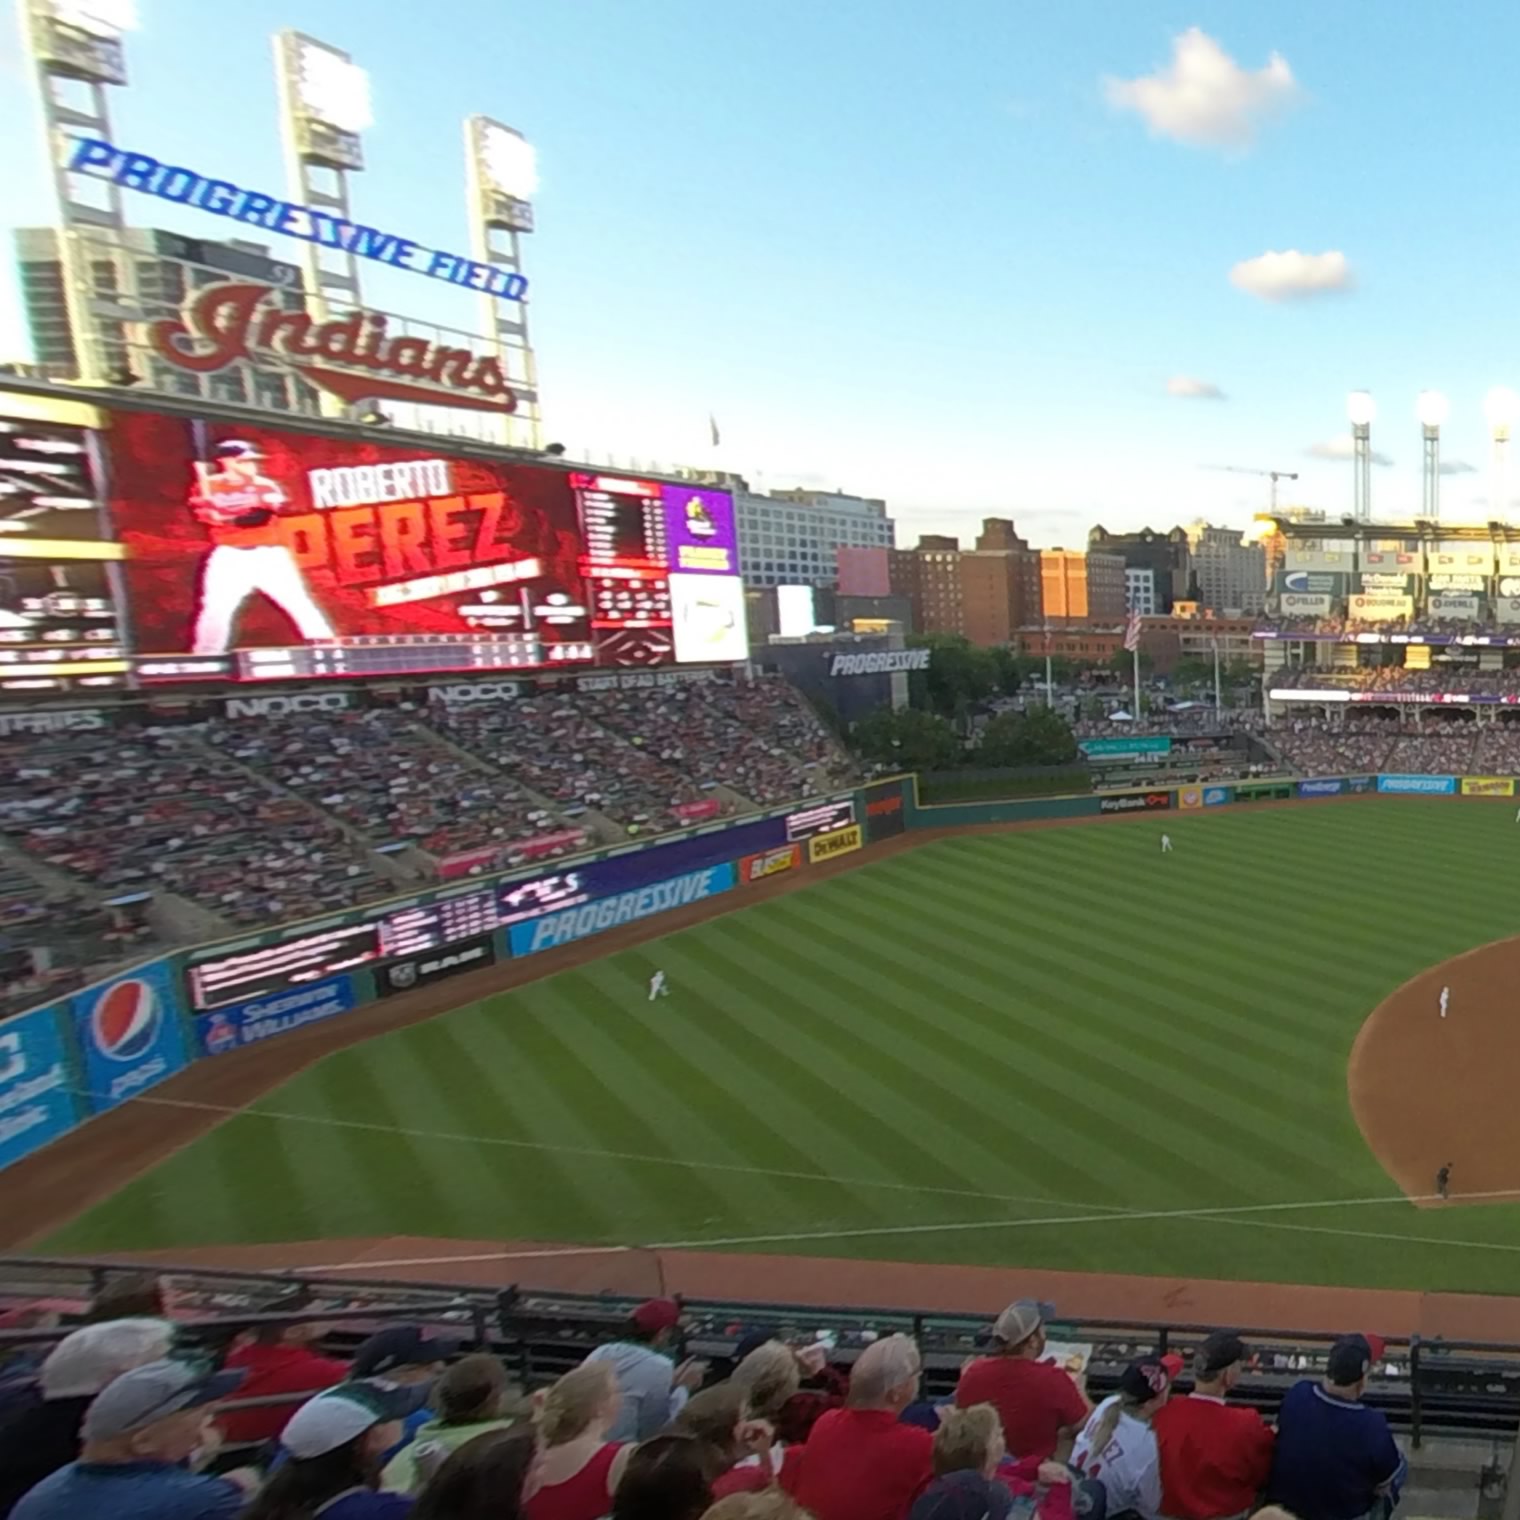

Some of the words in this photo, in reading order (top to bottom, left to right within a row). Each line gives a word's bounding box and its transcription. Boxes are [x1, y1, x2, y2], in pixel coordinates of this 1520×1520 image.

[70, 136, 419, 269] PROGRESSIVE
[426, 251, 529, 303] FIELD
[148, 281, 516, 402] Indians
[309, 459, 450, 508] ROBERTO
[280, 492, 510, 586] PEREZ
[1297, 596, 1325, 606] FELLER
[1442, 599, 1475, 609] AVERILL
[830, 648, 930, 676] PROGRESSIVE
[428, 682, 519, 701] NOCO
[577, 675, 618, 692] START
[620, 674, 655, 689] DEAD
[225, 693, 348, 719] NOCO
[1381, 778, 1451, 791] PROGRESSIVE
[1101, 793, 1146, 810] KeyBank
[530, 867, 718, 951] PROGRESSIVE
[420, 947, 484, 974] RAM
[243, 983, 338, 1023] SHERWIN
[242, 999, 348, 1042] WILLIAMS
